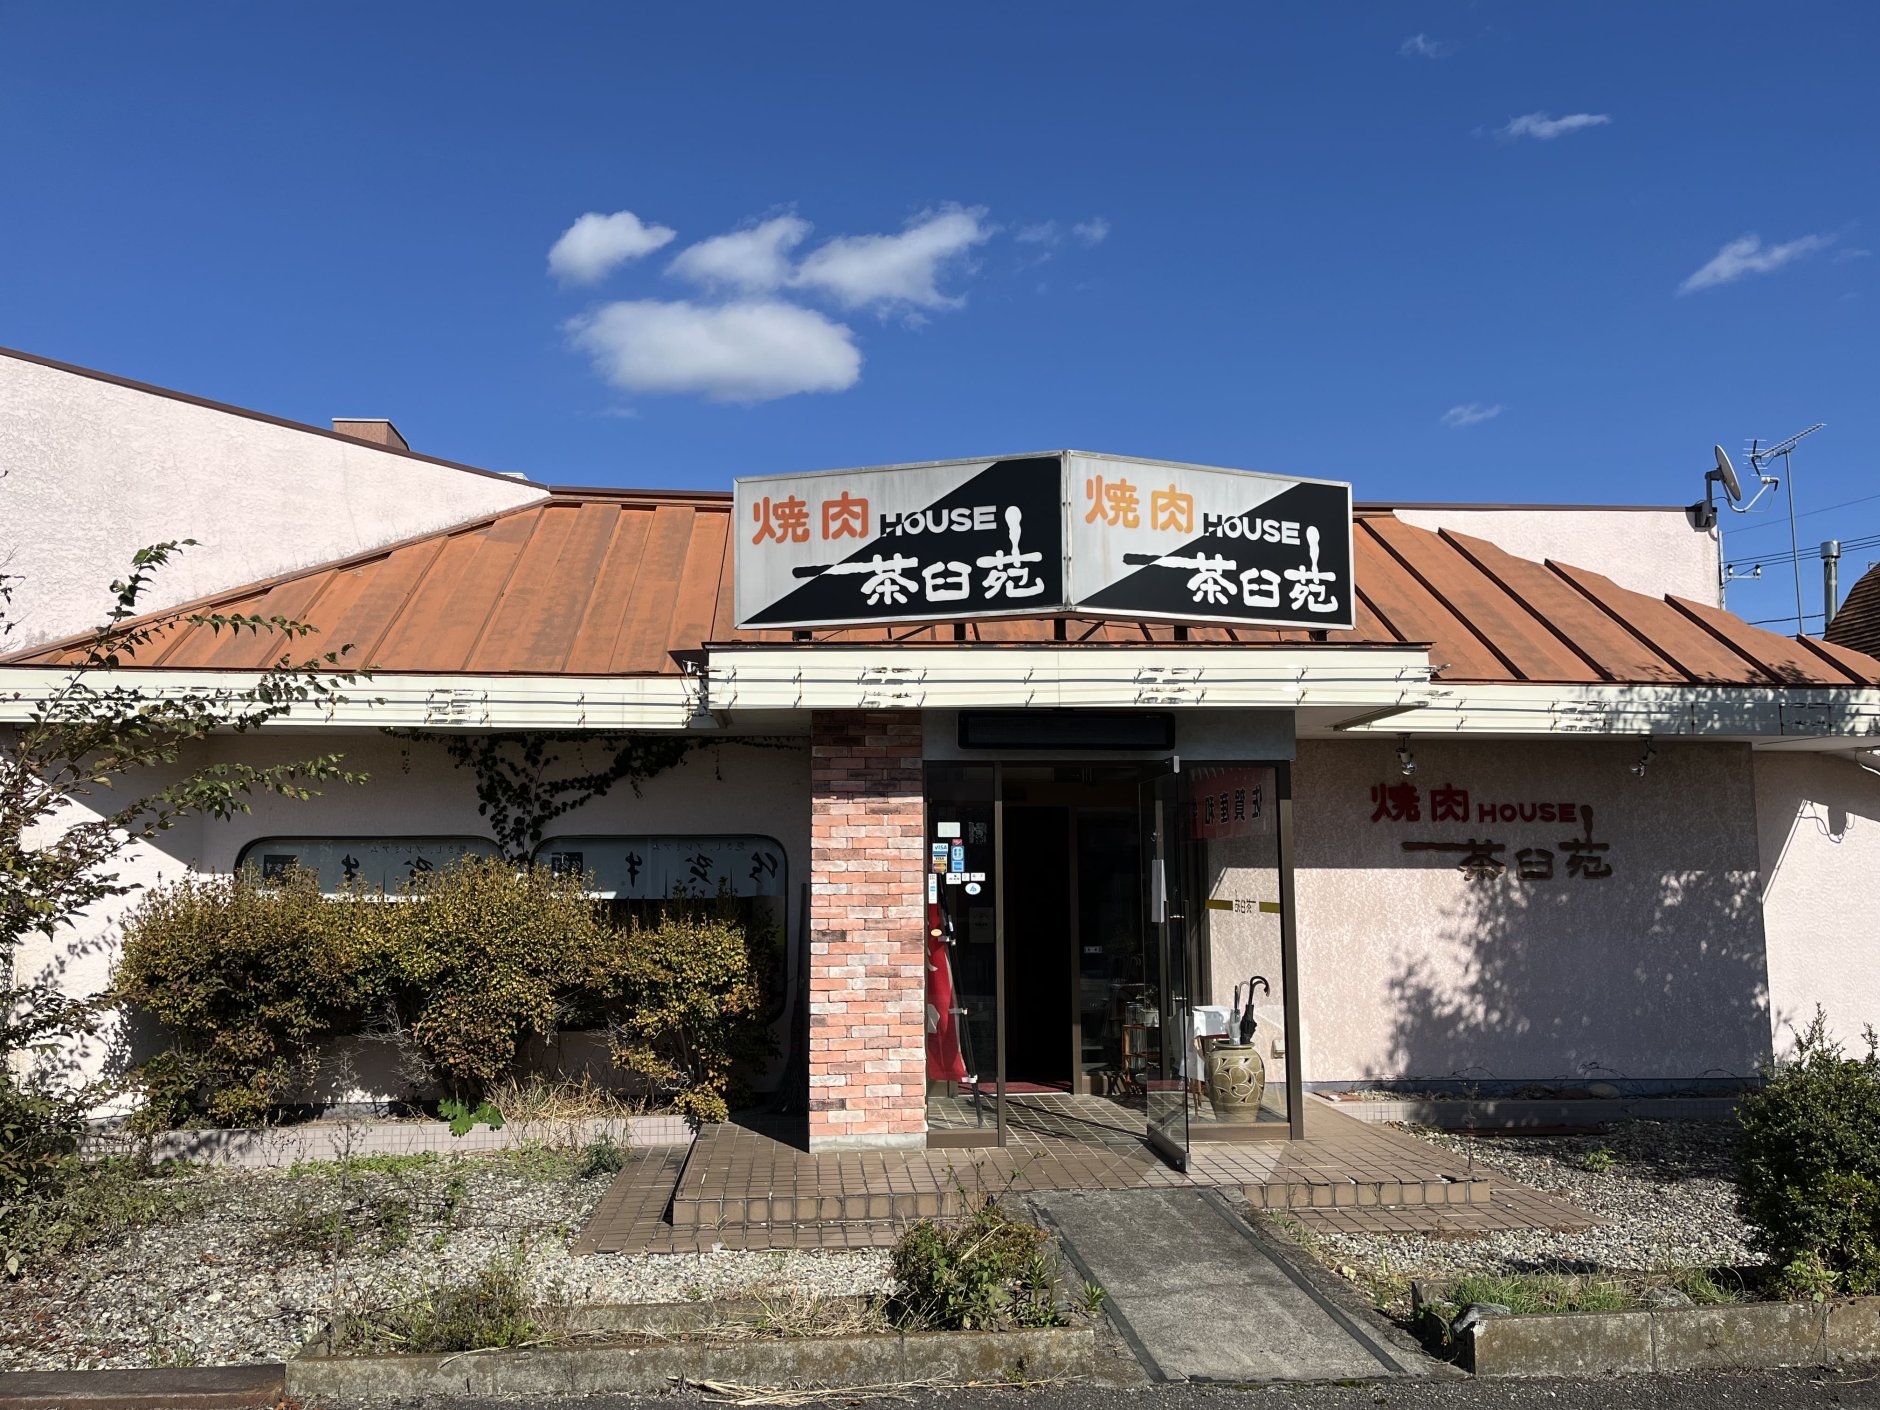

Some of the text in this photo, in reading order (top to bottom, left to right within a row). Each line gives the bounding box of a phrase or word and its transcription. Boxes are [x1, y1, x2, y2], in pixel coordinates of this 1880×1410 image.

[751, 489, 998, 546] 焼肉 HOUSE
[1085, 474, 1301, 547] 焼肉 HOUSE
[1370, 783, 1577, 824] 焼肉 HOUSE
